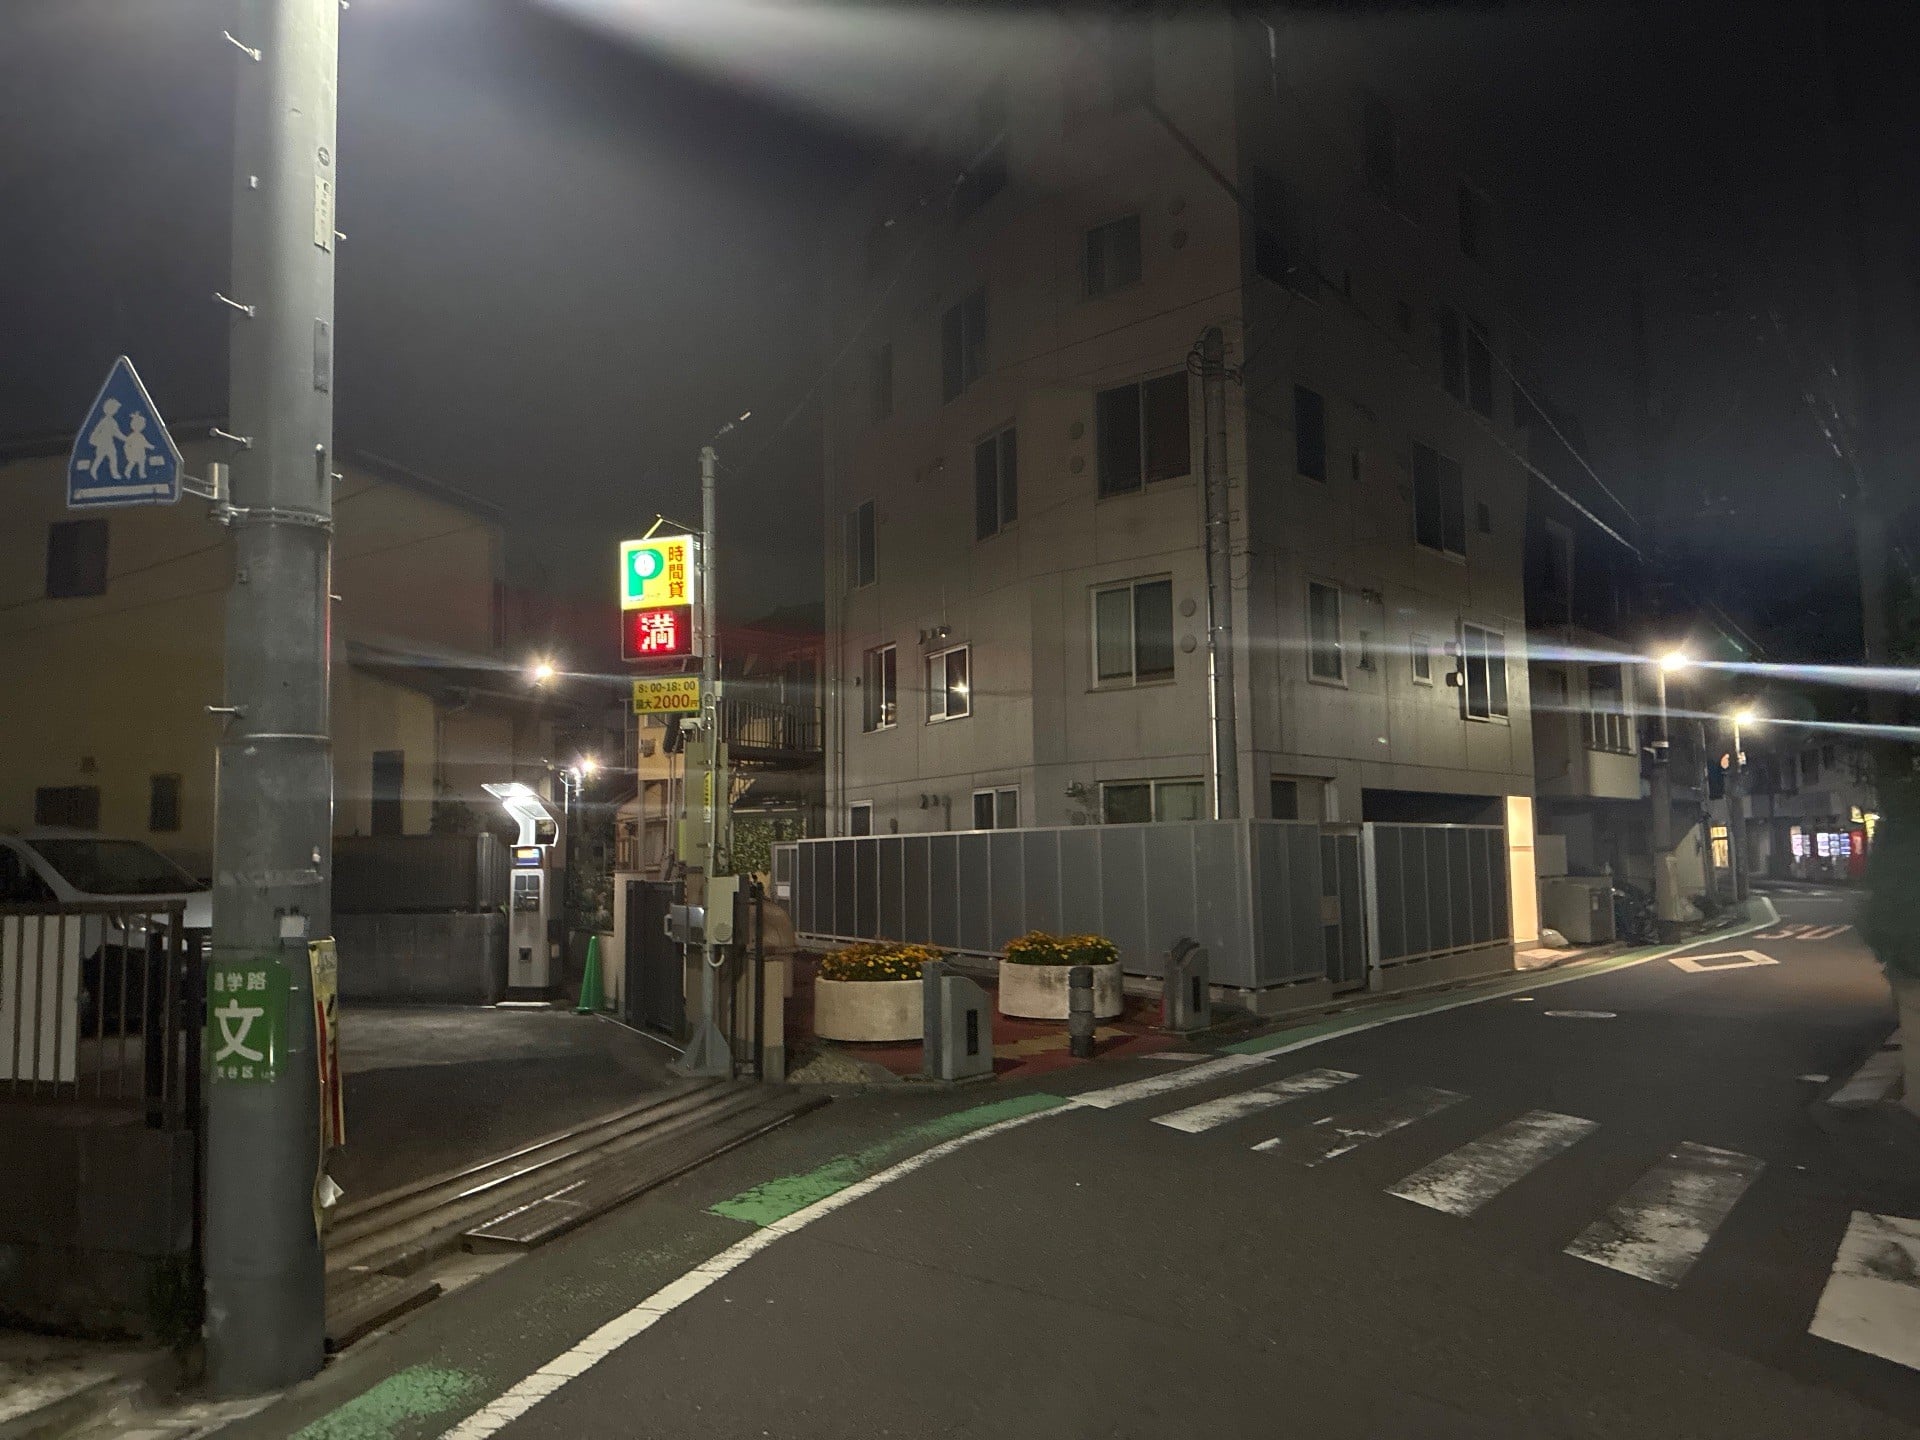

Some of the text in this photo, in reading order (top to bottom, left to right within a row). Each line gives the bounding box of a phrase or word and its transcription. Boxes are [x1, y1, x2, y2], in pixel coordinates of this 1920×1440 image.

[668, 545, 684, 599] 時間貸
[641, 613, 675, 650] 満
[214, 998, 264, 1062] 文
